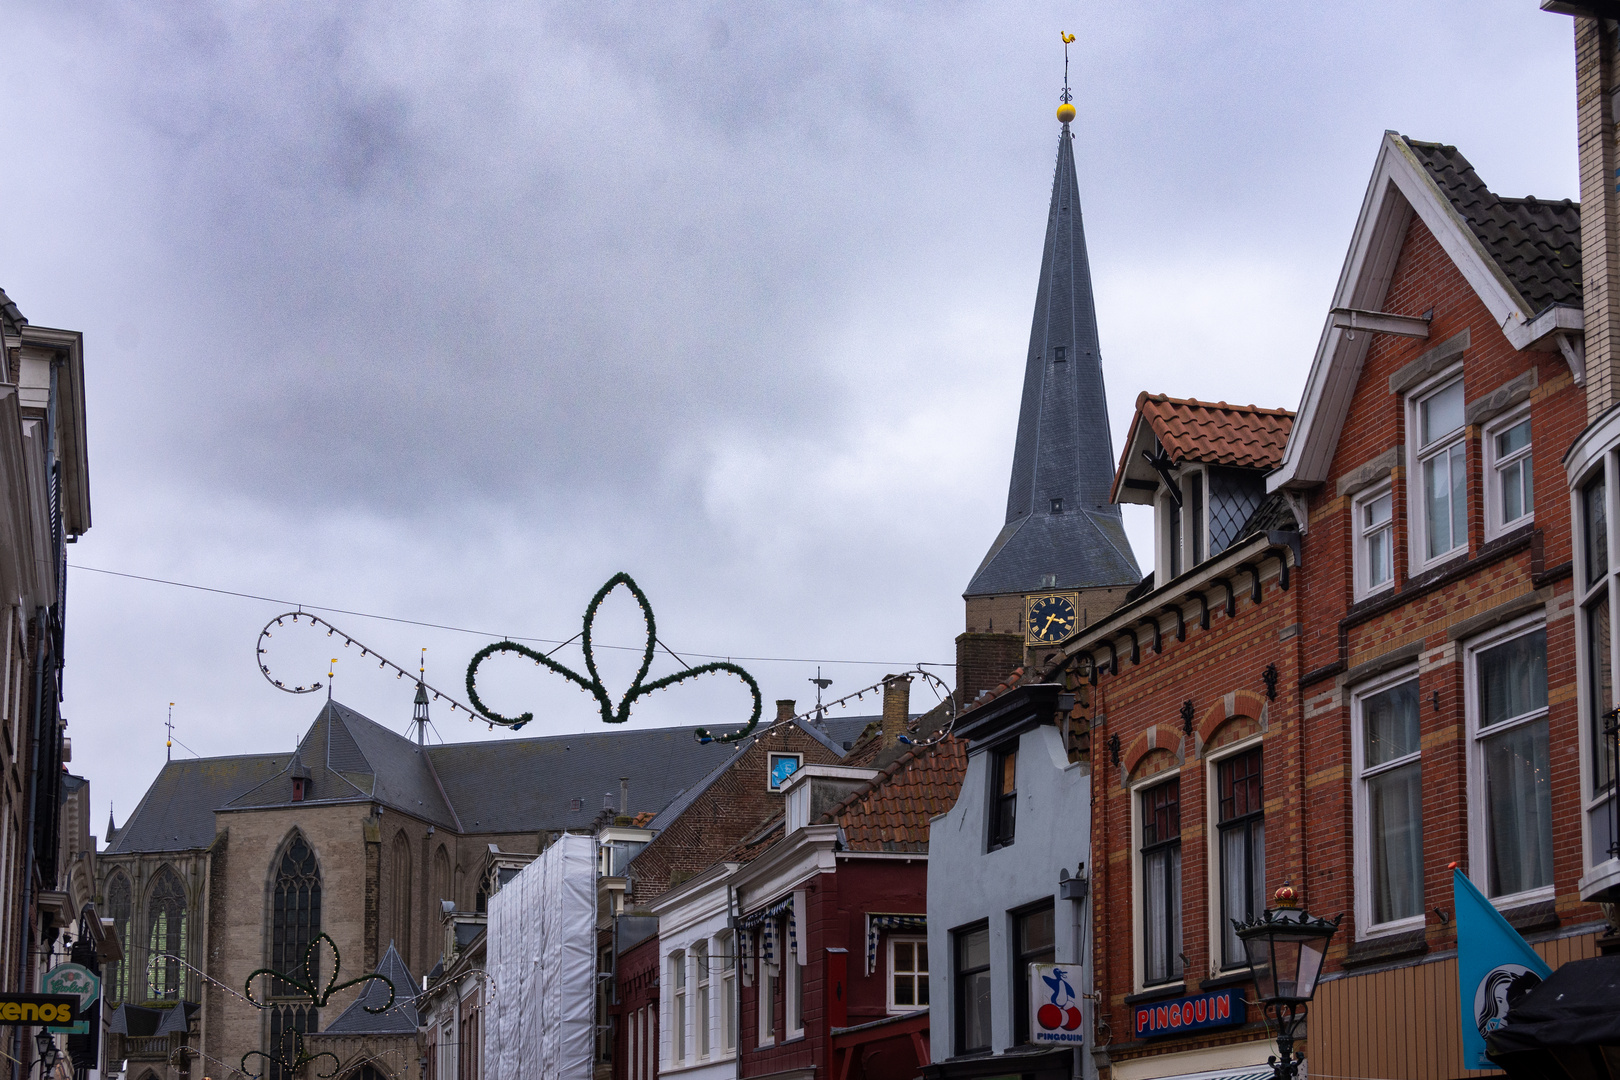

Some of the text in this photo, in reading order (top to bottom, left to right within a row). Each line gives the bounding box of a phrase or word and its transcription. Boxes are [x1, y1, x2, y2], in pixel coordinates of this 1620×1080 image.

[50, 979, 90, 994] Grolsch
[1137, 993, 1230, 1033] PINGOUIN
[1037, 1032, 1083, 1042] PINGOUIN
